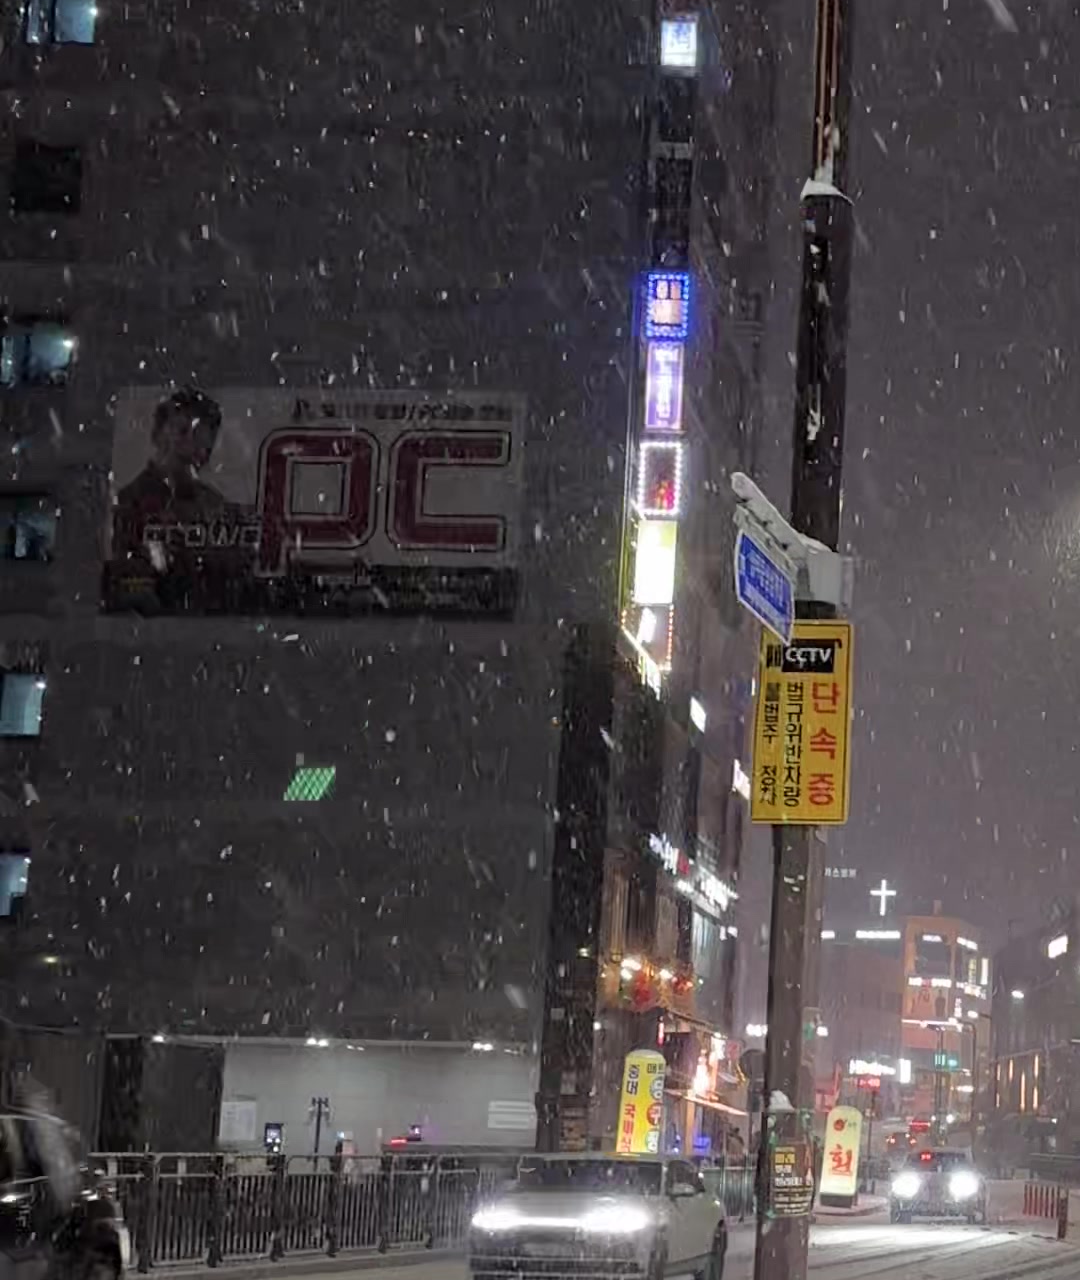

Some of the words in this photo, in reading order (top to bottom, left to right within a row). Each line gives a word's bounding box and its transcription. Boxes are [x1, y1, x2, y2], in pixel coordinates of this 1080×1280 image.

[785, 646, 832, 665] CCTV
[783, 681, 804, 808] 법규위반차량
[808, 681, 839, 806] 단속중
